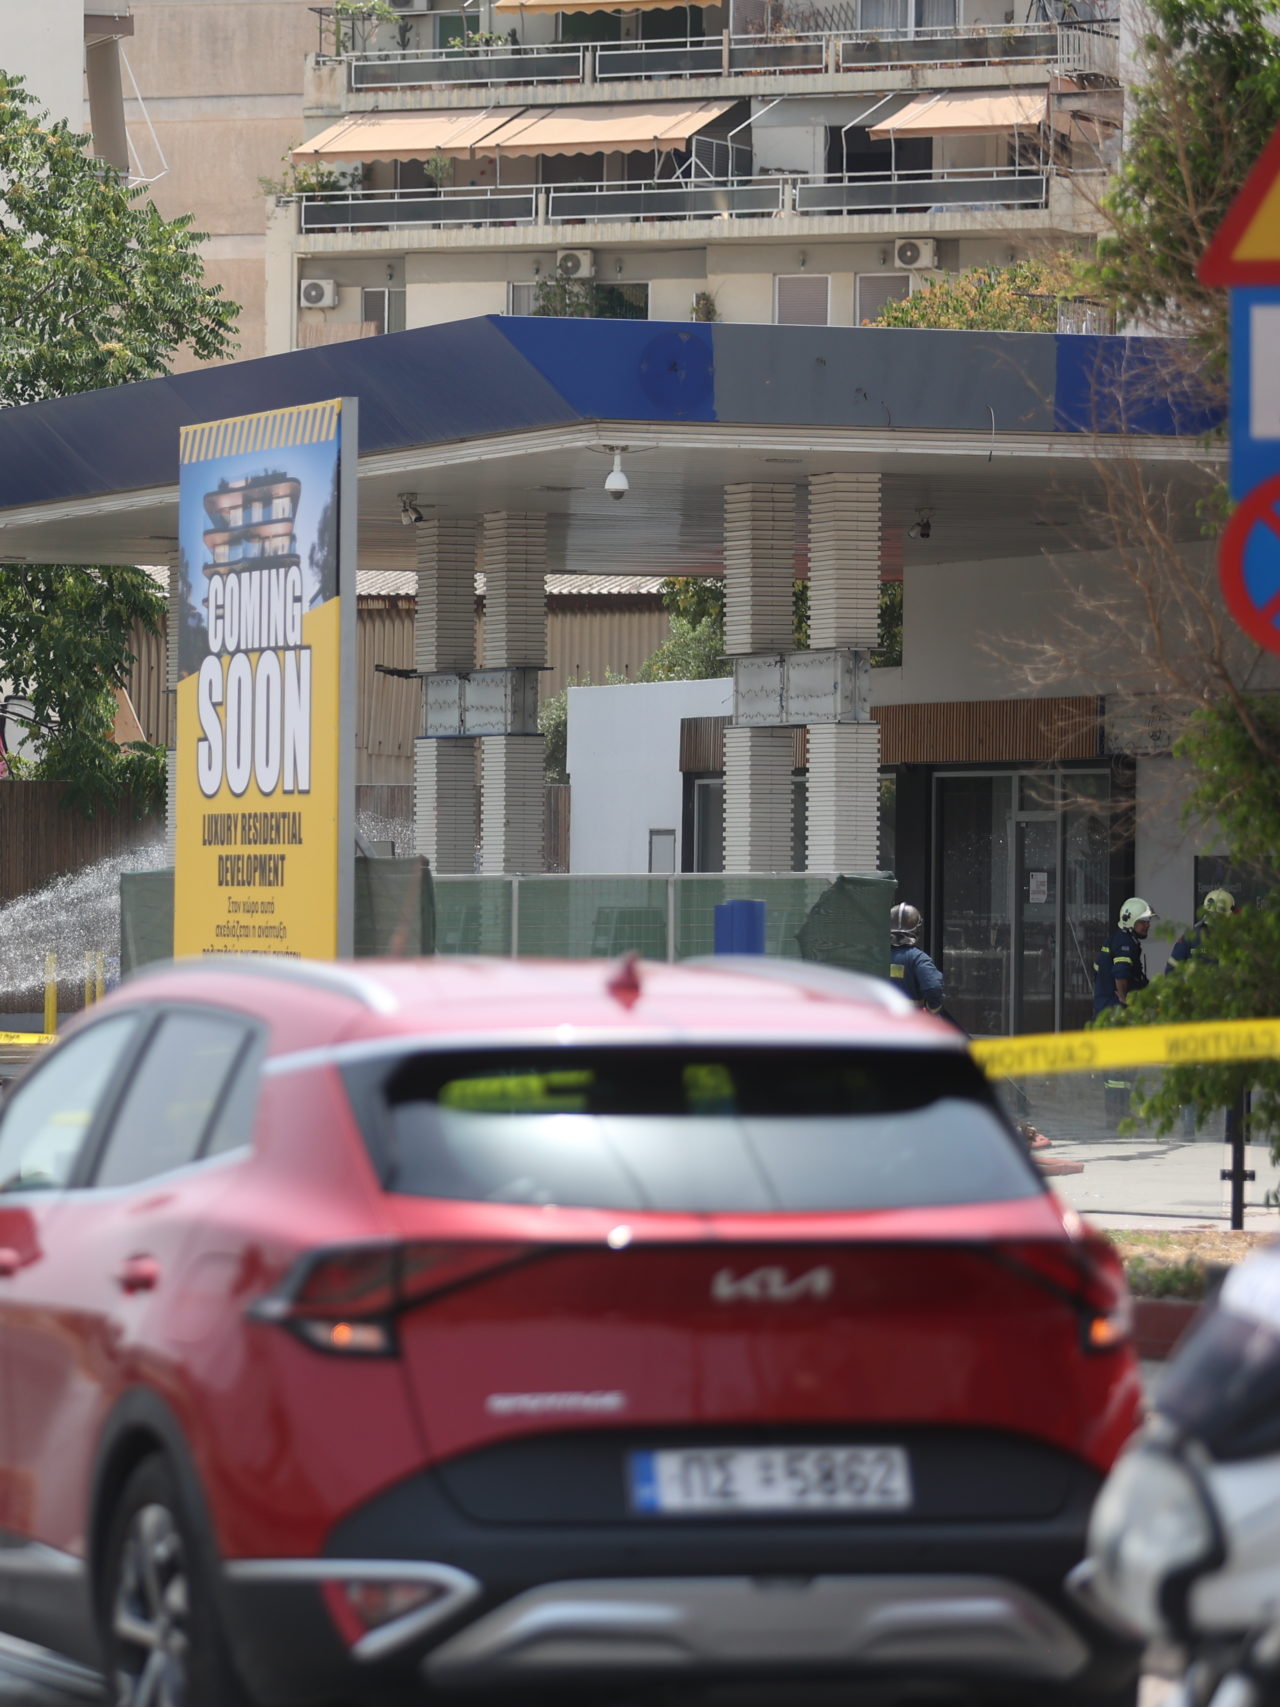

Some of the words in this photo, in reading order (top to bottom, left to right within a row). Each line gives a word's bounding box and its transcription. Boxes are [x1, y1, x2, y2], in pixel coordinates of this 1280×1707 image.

[208, 566, 303, 653] COMING
[197, 649, 312, 797] SOON
[202, 813, 239, 846] LUXURY
[240, 811, 303, 845] RESIDENTIAL
[218, 854, 286, 887] DEVELOPMENT
